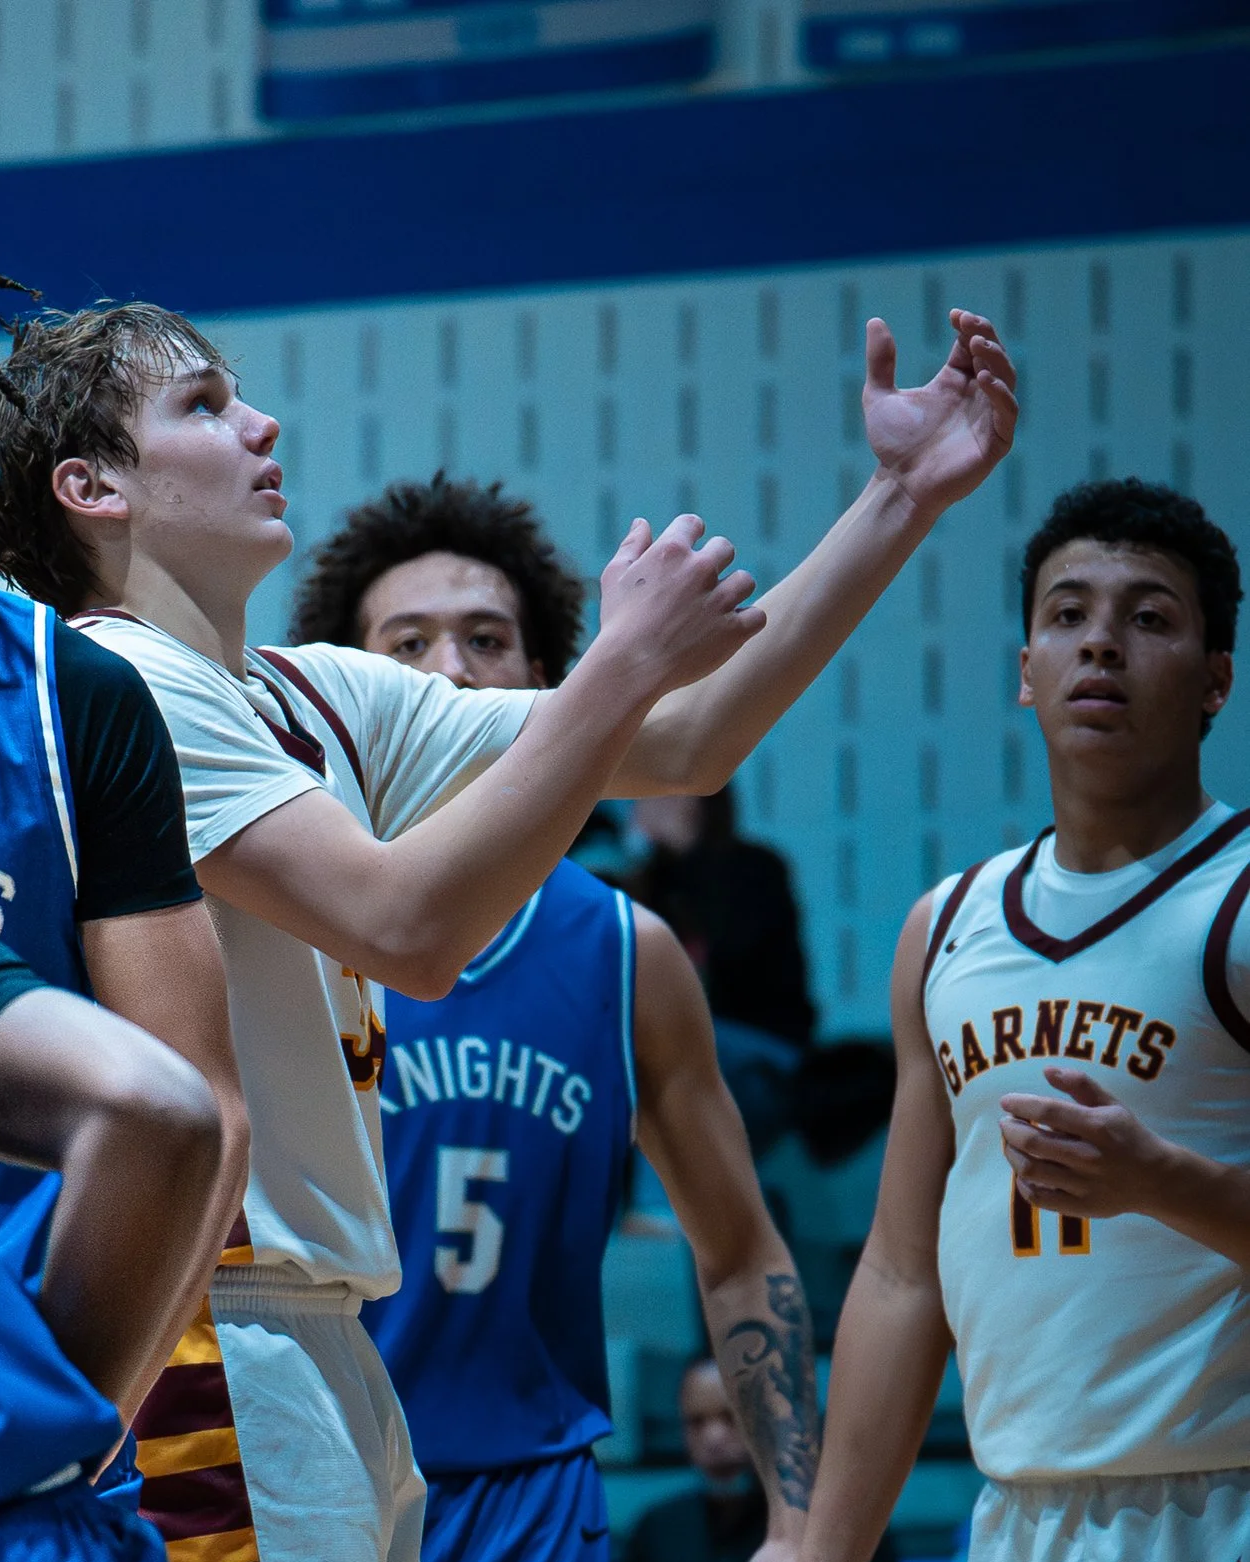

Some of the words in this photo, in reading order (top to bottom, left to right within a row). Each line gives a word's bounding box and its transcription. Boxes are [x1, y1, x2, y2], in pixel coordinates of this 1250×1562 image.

[379, 1035, 592, 1135] NIGHTS
[937, 999, 1177, 1098] GARNETS
[434, 1145, 510, 1295] 5
